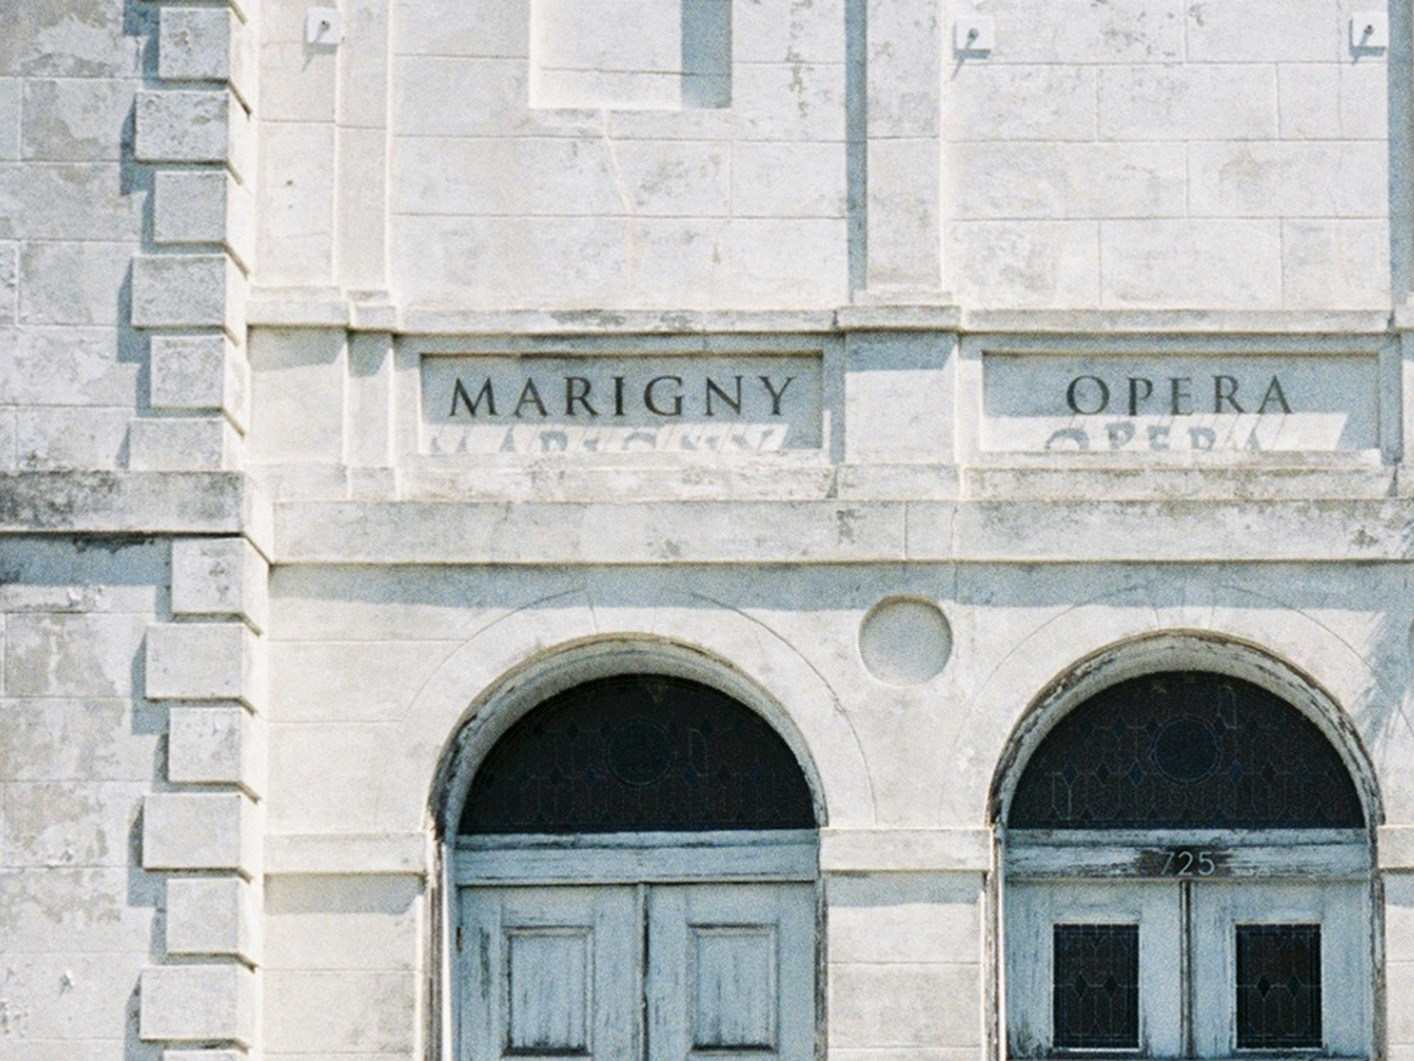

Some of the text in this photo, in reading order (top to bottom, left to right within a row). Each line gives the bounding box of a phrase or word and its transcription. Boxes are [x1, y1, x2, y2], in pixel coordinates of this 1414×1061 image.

[449, 375, 796, 417] MARIGNY
[1065, 374, 1293, 417] OPERA
[1160, 851, 1216, 876] 725
